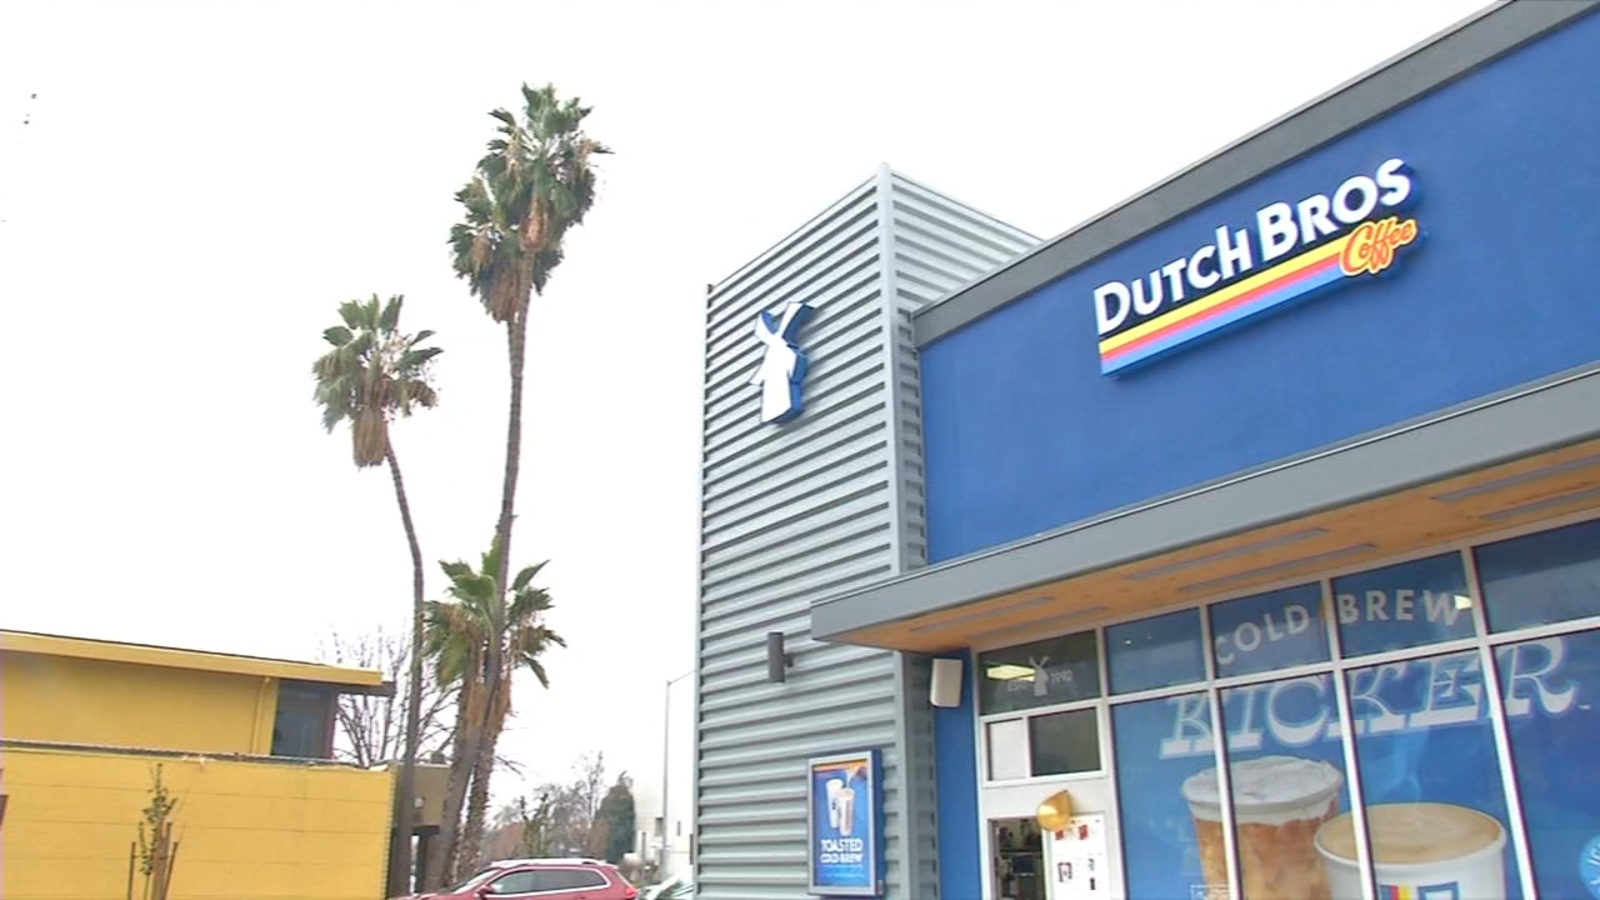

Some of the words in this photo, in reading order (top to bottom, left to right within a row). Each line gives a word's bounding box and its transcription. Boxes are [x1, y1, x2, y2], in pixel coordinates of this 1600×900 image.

[1094, 225, 1252, 336] DUTCH
[1256, 158, 1411, 262] BROS
[1342, 219, 1416, 275] Coffee
[1215, 604, 1310, 665] COLD
[1338, 588, 1470, 626] BREW
[1159, 634, 1577, 760] KICKER
[820, 838, 864, 852] TOASTED
